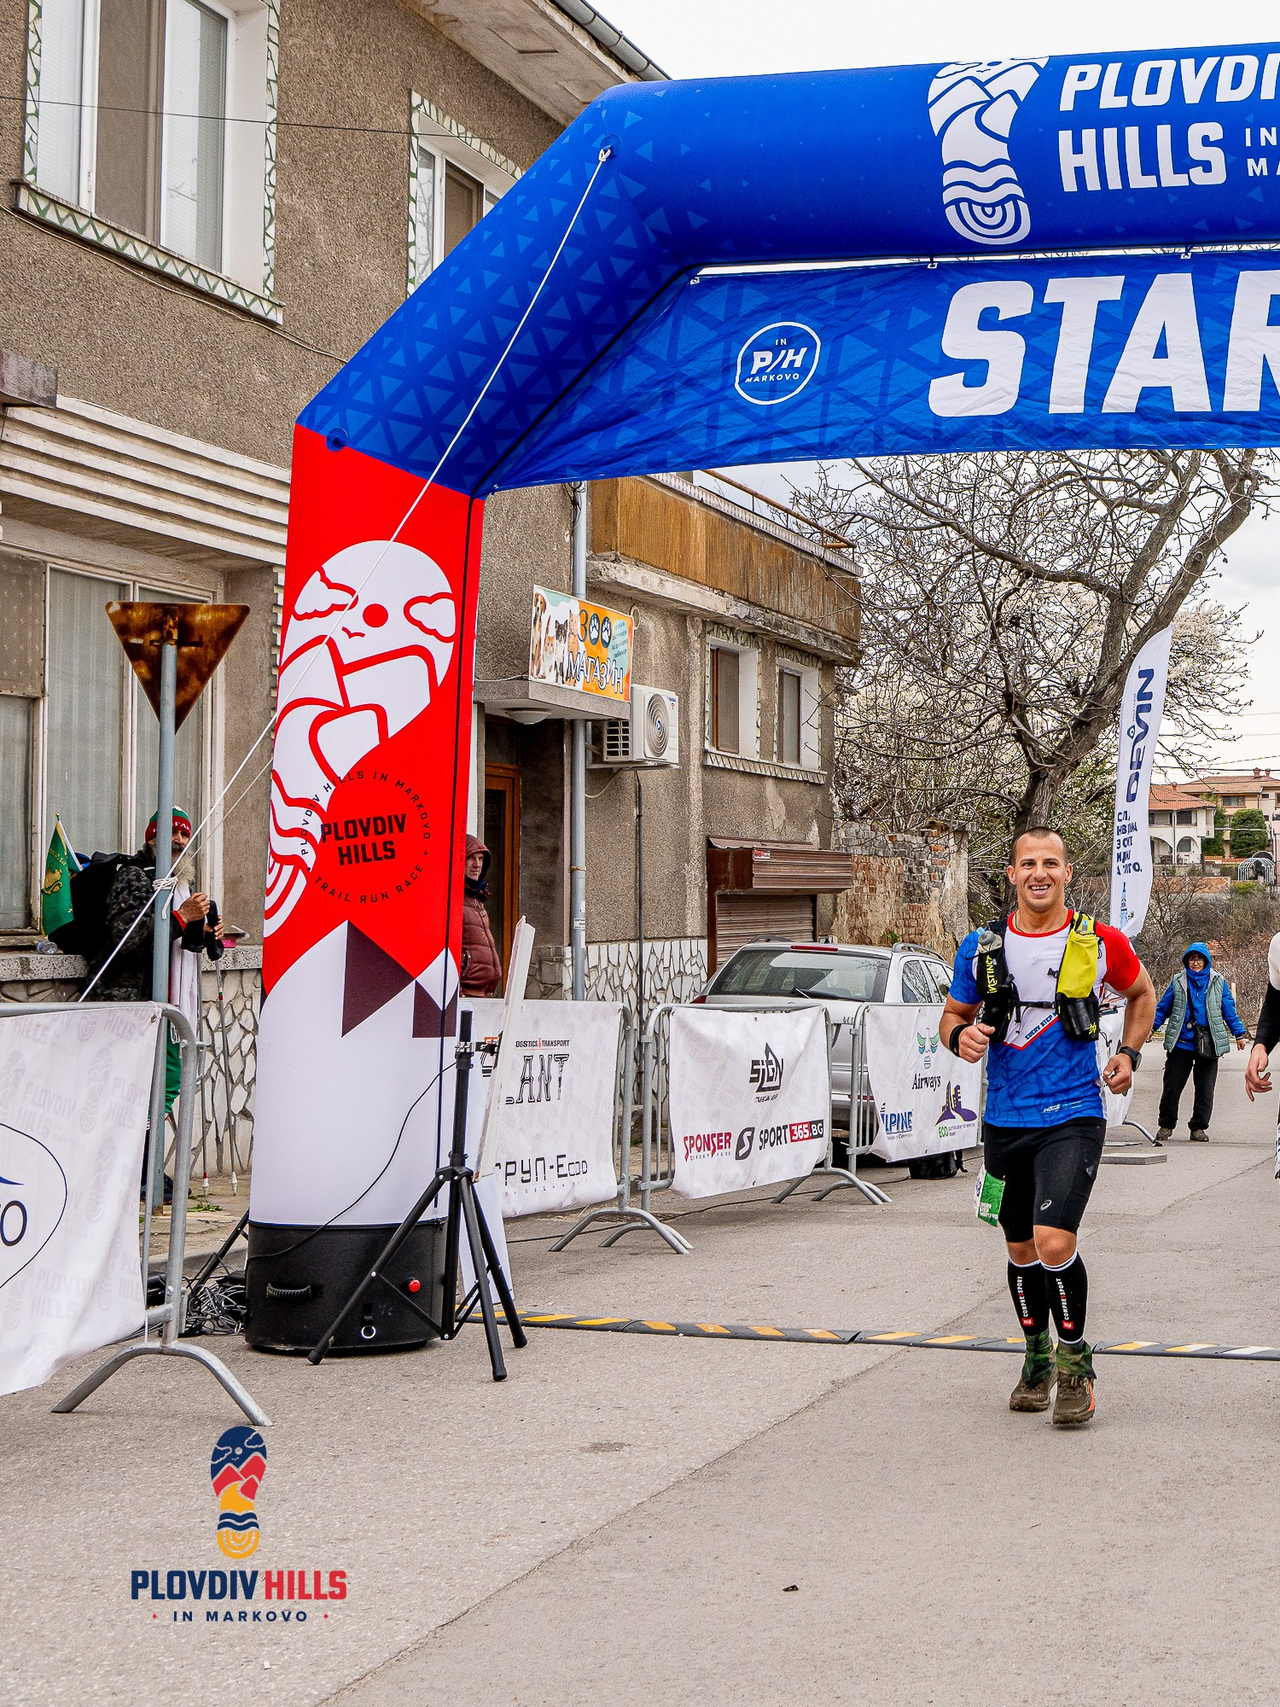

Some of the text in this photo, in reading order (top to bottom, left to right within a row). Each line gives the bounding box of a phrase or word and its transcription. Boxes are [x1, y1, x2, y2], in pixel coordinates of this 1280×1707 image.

[1244, 126, 1278, 148] IN
[1058, 122, 1227, 192] HILLS
[775, 338, 787, 346] IN
[750, 347, 808, 375] P/H
[744, 373, 800, 383] MARKOVO
[566, 651, 624, 694] МАГАЗИН
[300, 794, 320, 856] PLOVDIV
[321, 813, 406, 843] PLOVDIV
[338, 840, 396, 866] HILLS
[315, 864, 423, 903] TRAIL RUN RACE
[541, 1039, 570, 1047] TRANSPORT
[505, 1054, 569, 1105] ANT
[912, 1073, 941, 1091] Airways
[683, 1131, 732, 1162] SPONSER
[0, 1200, 27, 1246] O
